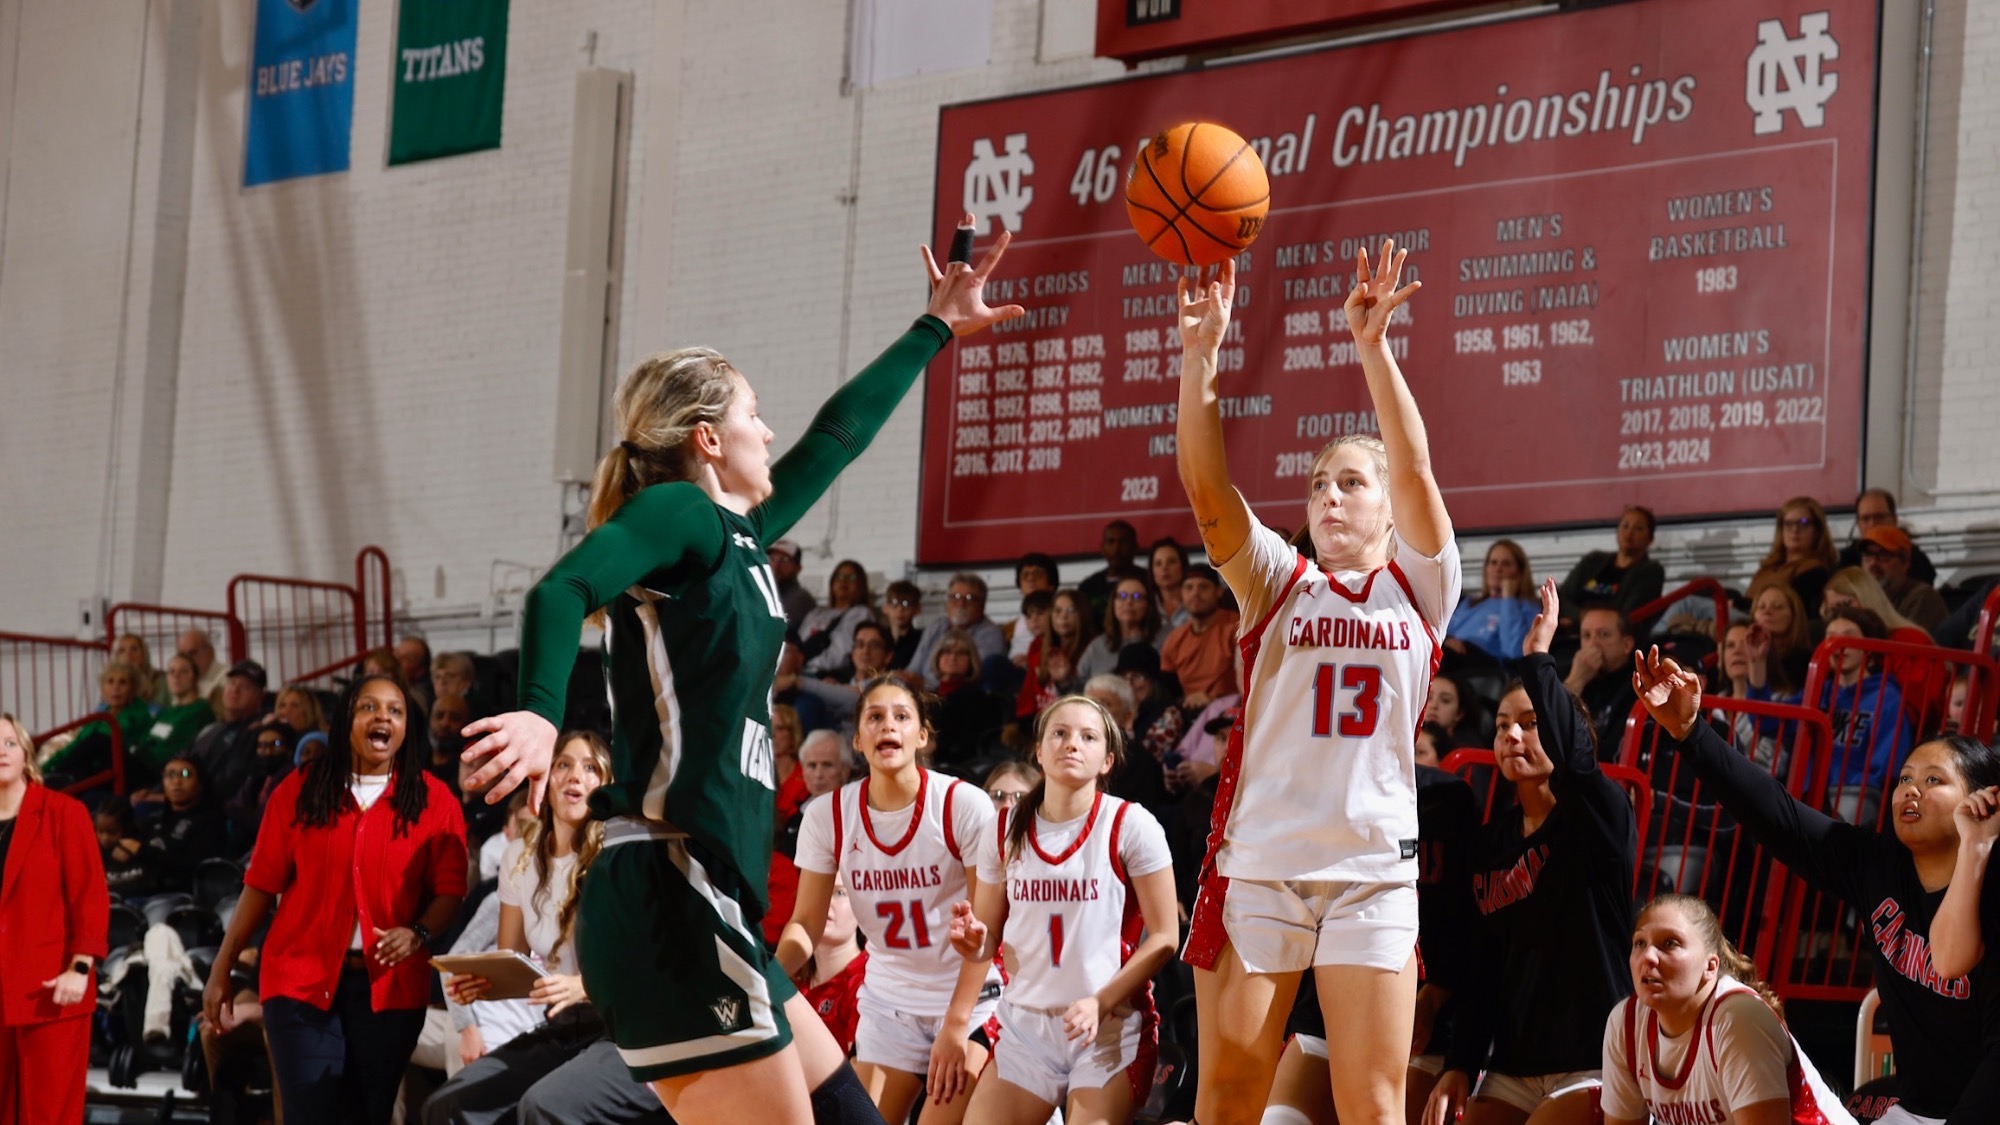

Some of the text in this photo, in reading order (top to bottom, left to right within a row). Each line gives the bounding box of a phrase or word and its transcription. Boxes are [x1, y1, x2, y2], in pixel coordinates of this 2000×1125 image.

[402, 37, 485, 82] TITANS
[257, 53, 347, 96] BLUE JAYS
[1069, 145, 1121, 206] 46
[1332, 66, 1696, 167] Championships
[1667, 186, 1773, 222] WOMEN'S
[1496, 214, 1562, 242] MEN'S
[1649, 223, 1788, 261] BASKETBALL
[1275, 239, 1334, 268] MEN'S
[1459, 247, 1597, 282] SWIMMING &
[1034, 270, 1089, 295] CROSS
[1122, 263, 1178, 287] MEN'S
[1284, 273, 1342, 300] TRACK
[1695, 265, 1738, 294] 1983
[1122, 294, 1177, 319] TRACK
[1454, 281, 1598, 318] DIVING (NAIA)
[992, 306, 1070, 333] COUNTRY
[1284, 311, 1323, 336] 1989,
[1125, 328, 1162, 353] 1989,
[1454, 318, 1594, 354] 1958, 1961, 1962,
[1663, 329, 1770, 363] WOMEN'S
[960, 335, 1105, 369] 1975, 1976, 1978, 1979,
[1123, 356, 1162, 382] 2012,
[1218, 348, 1245, 372] 019
[1283, 345, 1324, 371] 2000,
[1502, 359, 1542, 386] 1963
[1619, 362, 1815, 403] TRIATHLON (USAT)
[1104, 402, 1177, 429] WOMEN'S
[1297, 410, 1379, 438] FOOTBAL
[1620, 408, 1664, 435] 2017,
[1669, 404, 1714, 432] 2018,
[1719, 401, 1770, 430] 2019,
[993, 423, 1026, 445] 2011,
[1029, 419, 1064, 443] 2012,
[1067, 416, 1100, 440] 2014
[991, 449, 1024, 474] 2017,
[1121, 476, 1159, 501] 2023
[1289, 616, 1411, 651] CARDINALS
[1311, 662, 1383, 738] 13
[851, 864, 942, 891] CARDINALS
[1013, 878, 1098, 901] CARDINALS
[875, 899, 932, 949] 21
[1047, 913, 1065, 968] 1
